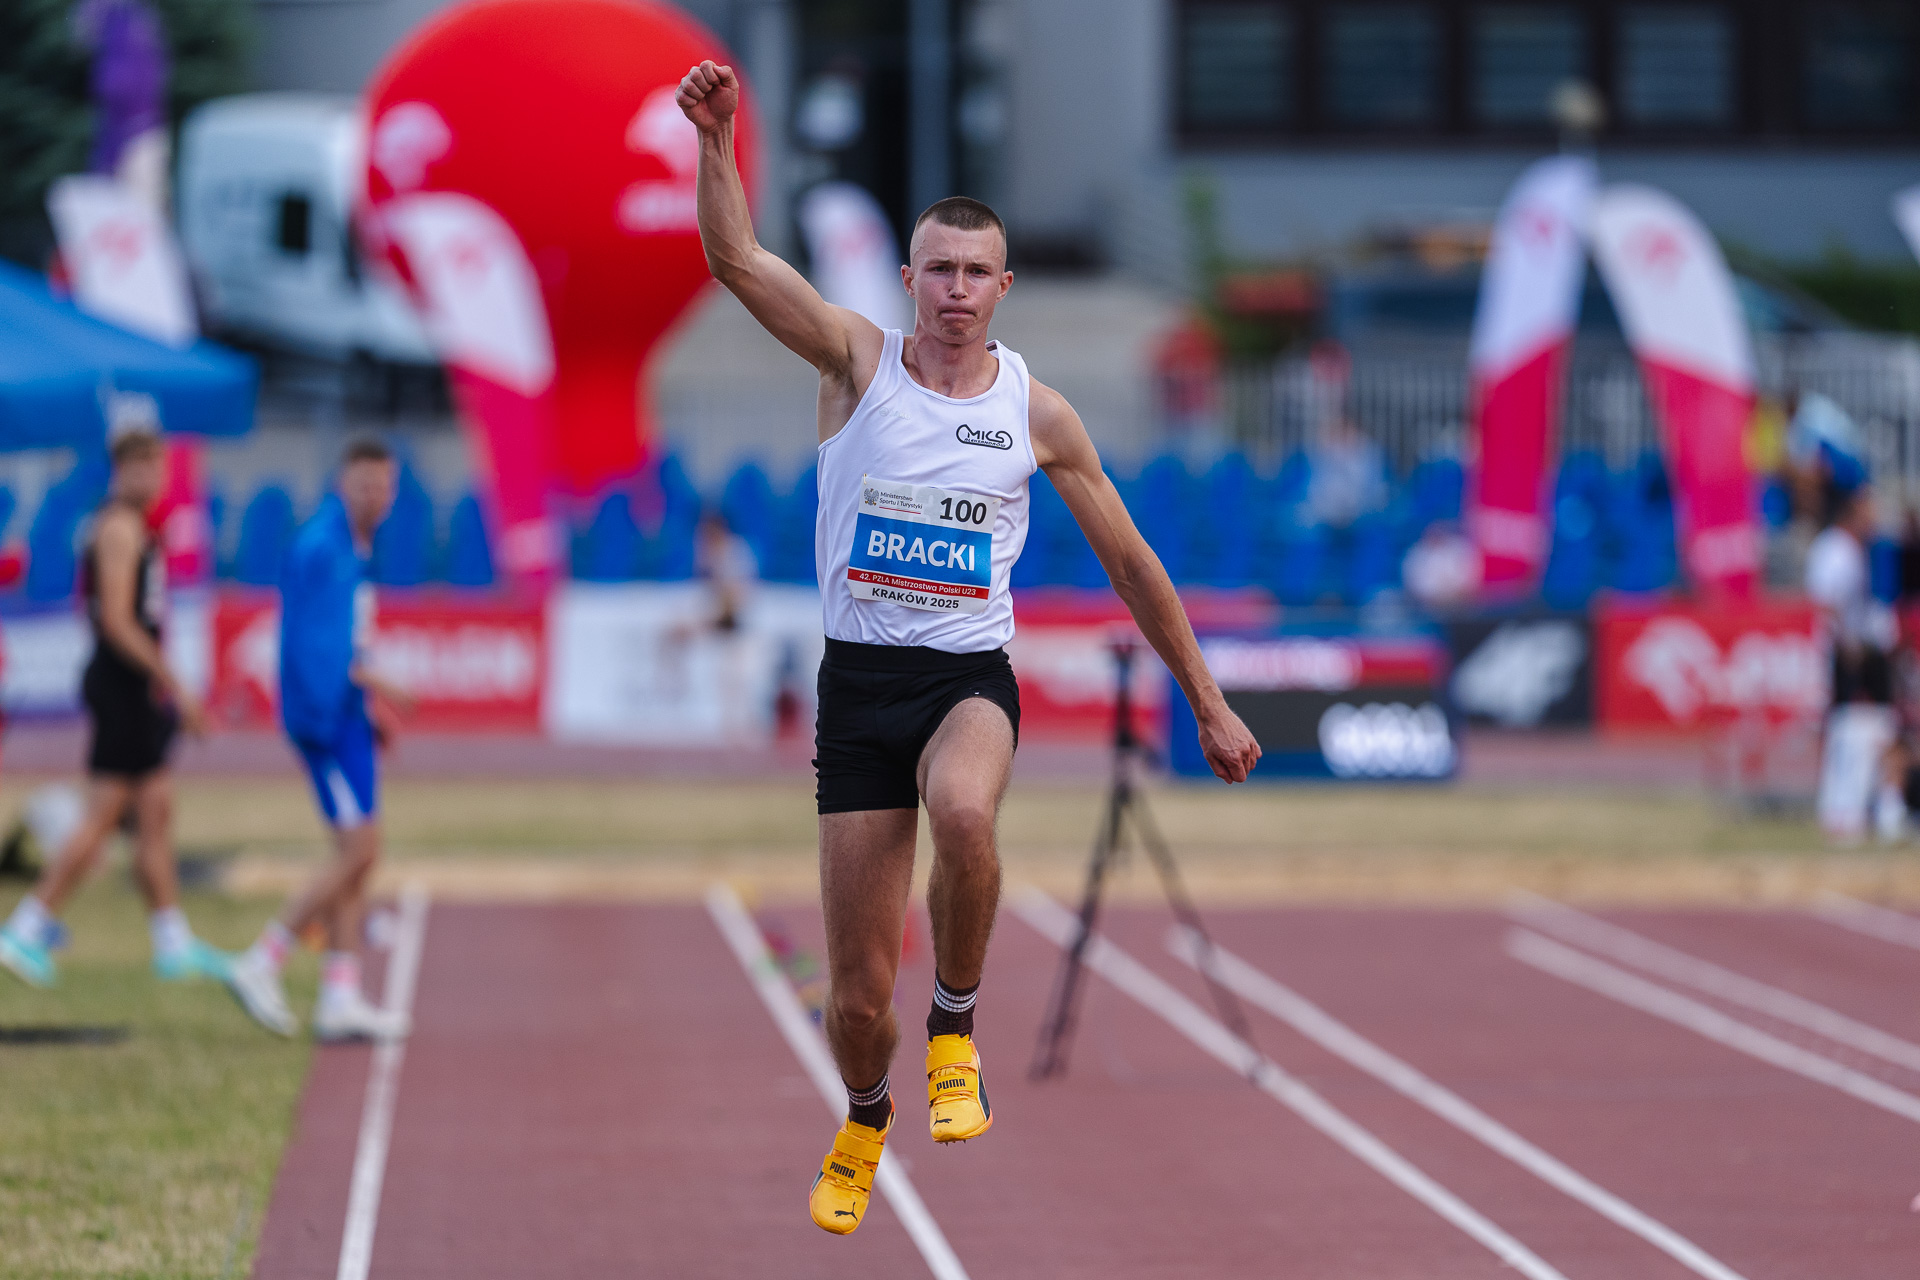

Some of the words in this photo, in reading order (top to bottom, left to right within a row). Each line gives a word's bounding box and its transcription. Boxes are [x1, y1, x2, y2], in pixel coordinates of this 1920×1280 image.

[879, 497, 896, 505] Sportu
[900, 500, 923, 509] Turystyki
[880, 491, 913, 501] Ministerstwo
[939, 497, 987, 525] 100
[866, 529, 975, 571] BRACKI
[859, 572, 871, 581] 42.
[872, 575, 890, 584] PZLA
[891, 578, 937, 592] Mistrzostwa
[938, 585, 961, 595] Polski
[961, 588, 977, 596] U23
[871, 587, 928, 605] KRAKÓW
[929, 597, 960, 609] 2025
[936, 1078, 966, 1092] PUMA
[829, 1161, 856, 1179] PUMA
